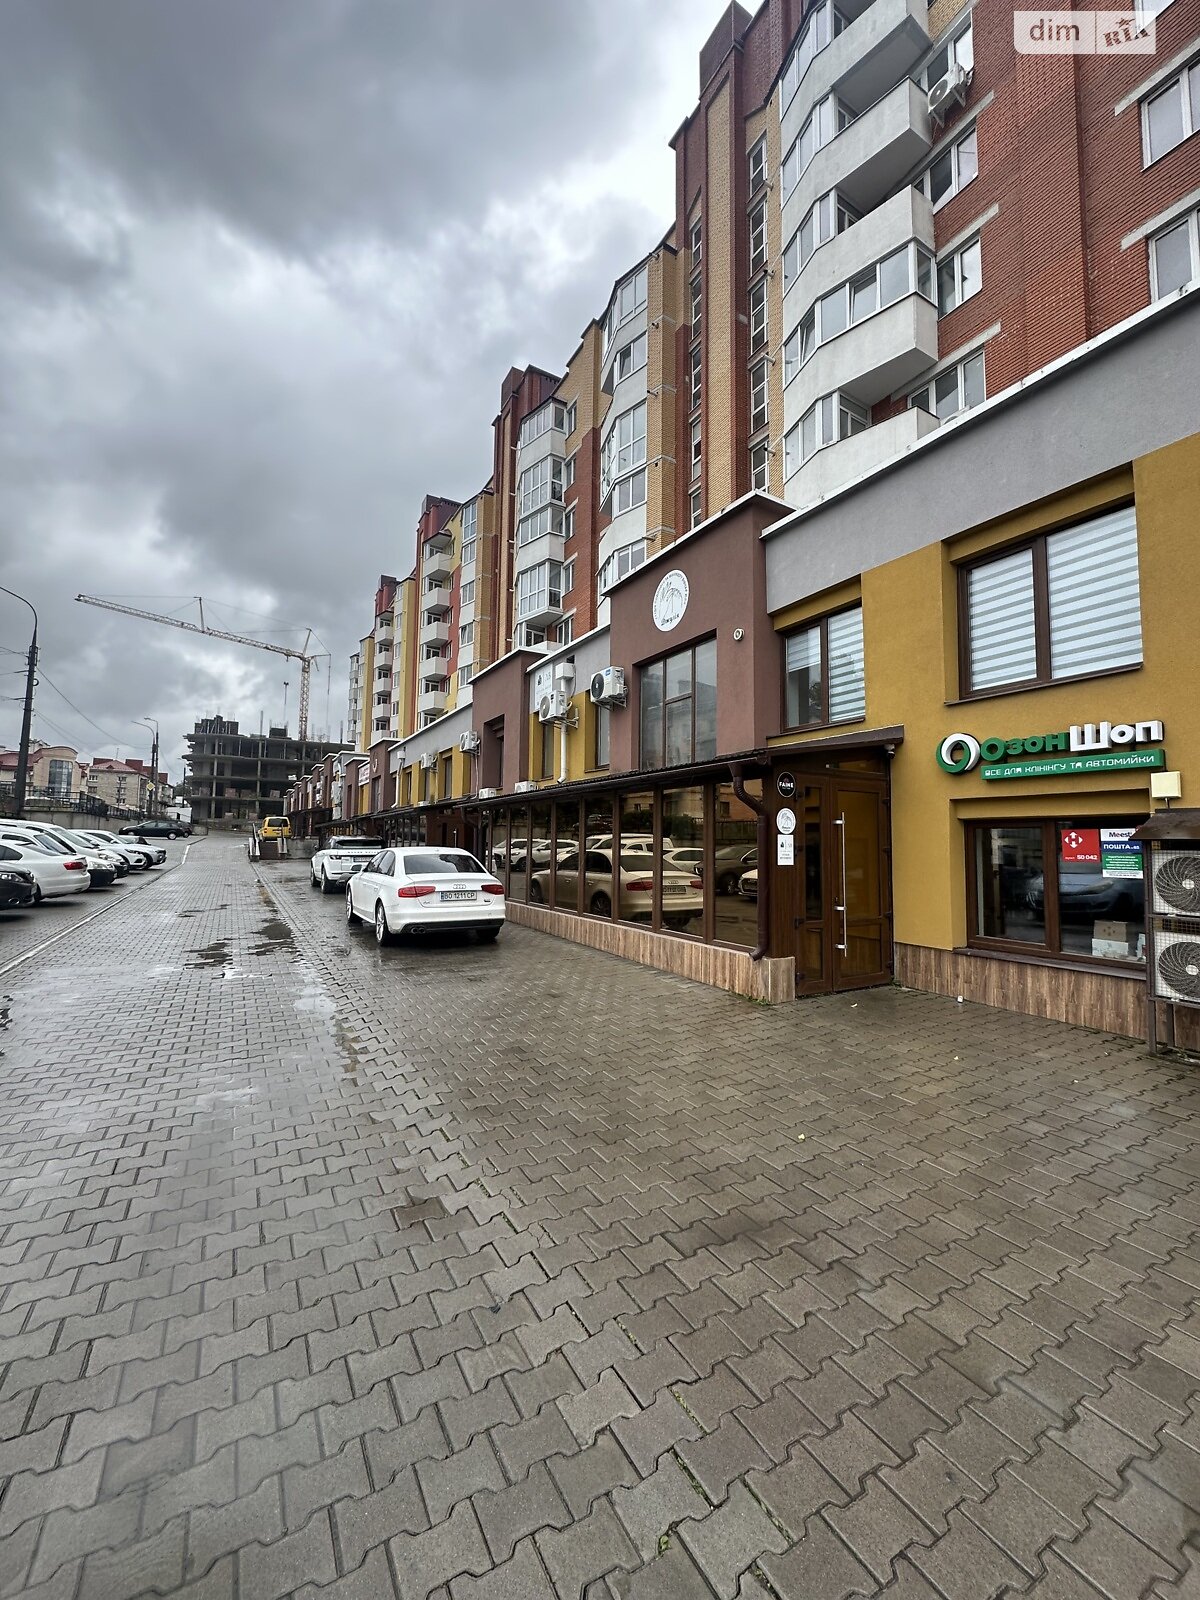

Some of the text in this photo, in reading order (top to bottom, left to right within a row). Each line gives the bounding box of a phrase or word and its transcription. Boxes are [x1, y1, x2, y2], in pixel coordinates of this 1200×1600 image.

[1004, 767, 1022, 776] ДЛЯ
[1025, 763, 1066, 773] КЛІНІНГУ
[1069, 761, 1083, 769] ТА
[1085, 755, 1155, 768] АВТОМИЙКИ
